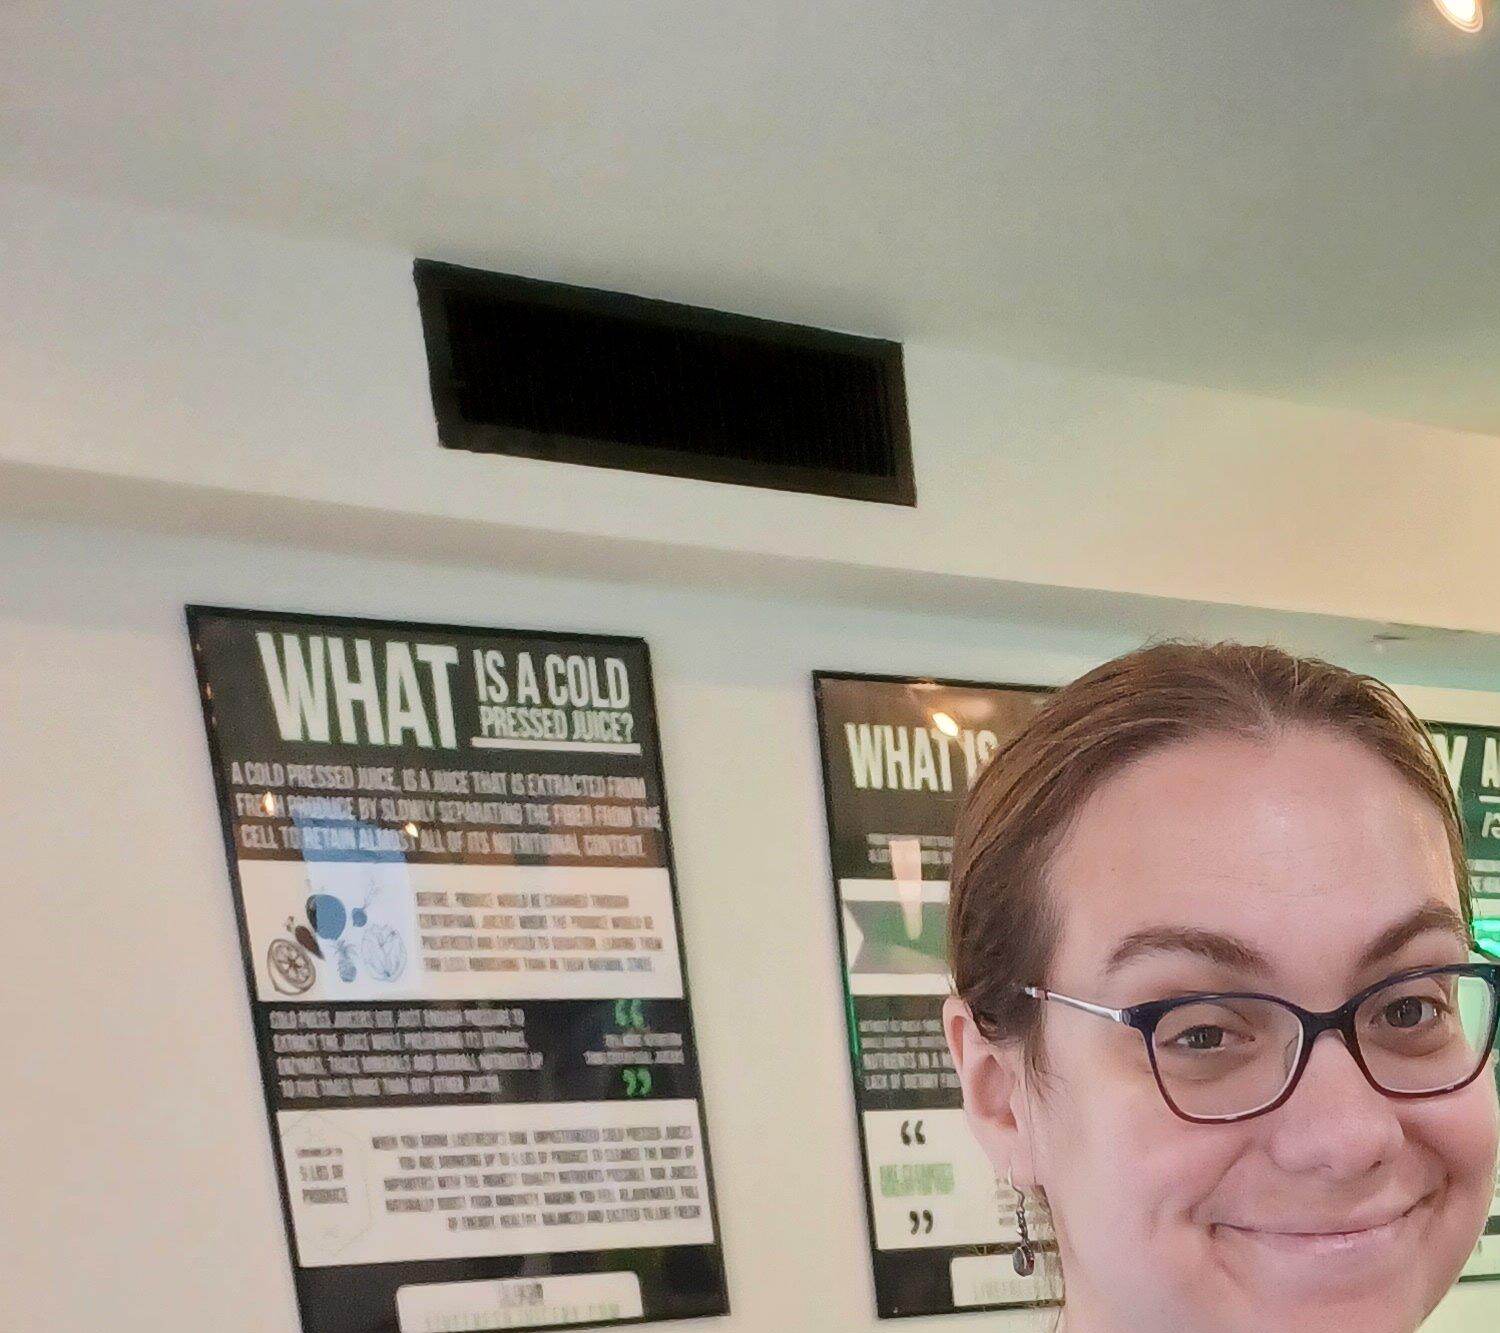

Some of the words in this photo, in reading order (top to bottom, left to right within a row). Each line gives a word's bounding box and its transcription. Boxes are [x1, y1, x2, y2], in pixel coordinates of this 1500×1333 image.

[255, 632, 459, 750] WHAT
[473, 649, 509, 703] IS
[517, 652, 541, 704] A
[545, 654, 630, 709] COLD
[480, 706, 568, 740] PRESSED
[572, 710, 634, 743] JUICE?
[244, 762, 284, 786] COLD
[286, 764, 354, 789] PRESSED
[845, 723, 953, 792] WHAT
